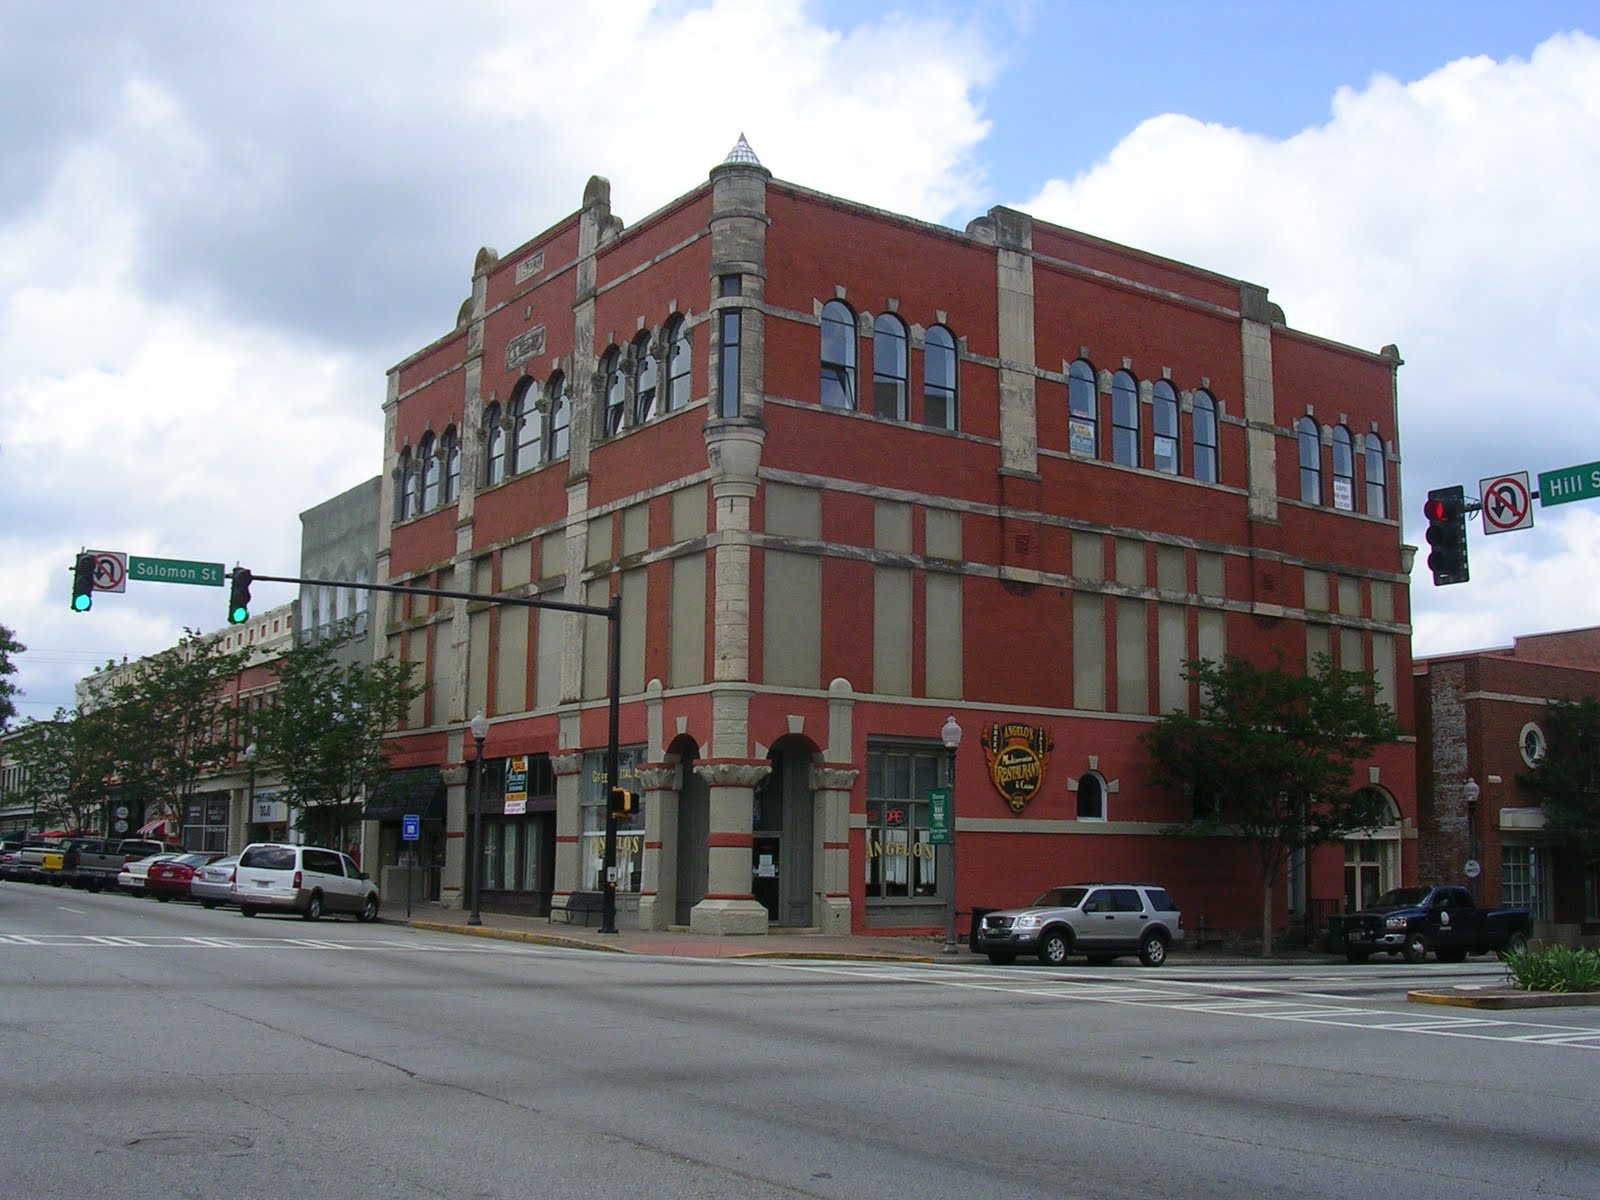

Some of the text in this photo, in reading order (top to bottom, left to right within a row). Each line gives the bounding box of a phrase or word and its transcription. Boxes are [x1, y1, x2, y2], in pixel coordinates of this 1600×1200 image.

[1550, 470, 1600, 497] Hill S
[137, 562, 216, 581] Solomon St
[1004, 725, 1034, 740] ANGELO'S
[592, 770, 609, 784] GREE
